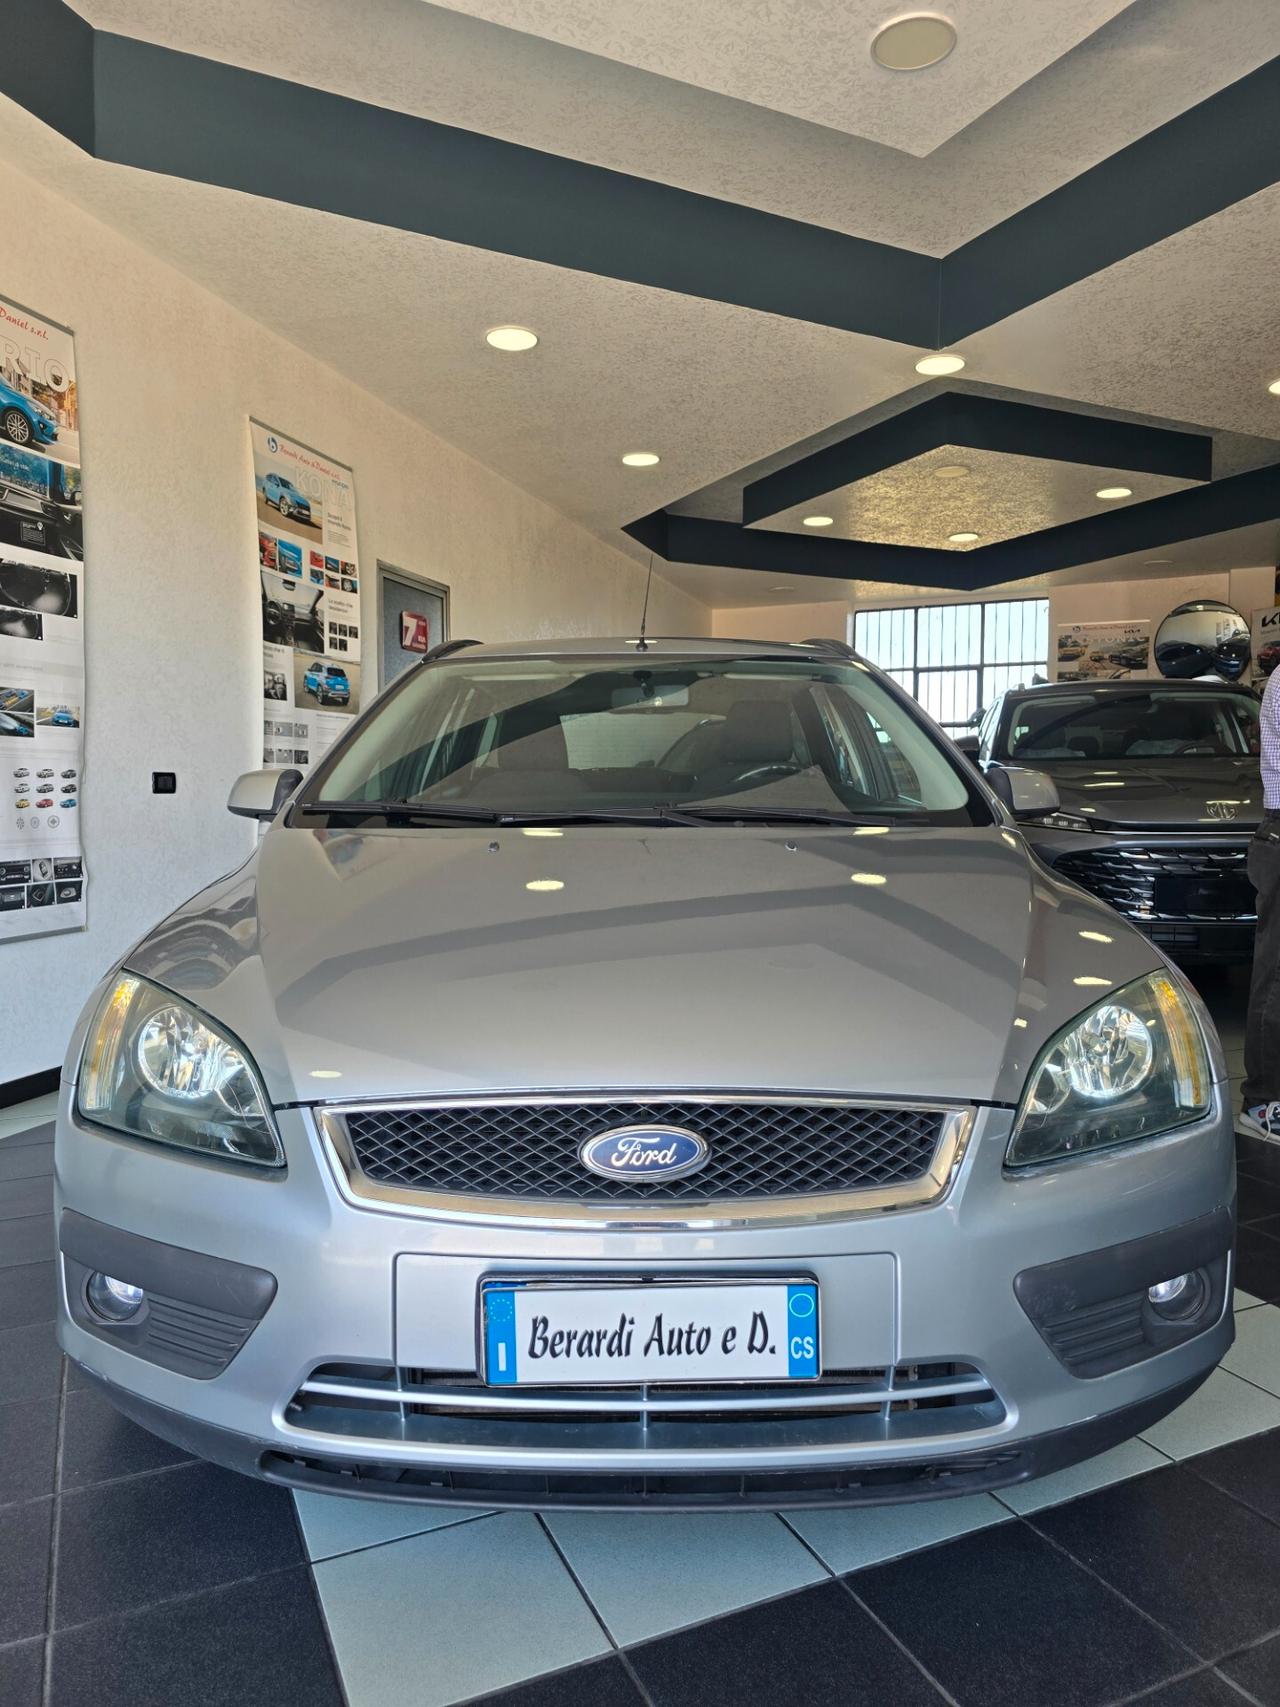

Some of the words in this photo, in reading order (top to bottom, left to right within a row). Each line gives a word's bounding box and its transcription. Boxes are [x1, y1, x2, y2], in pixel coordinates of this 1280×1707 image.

[0, 306, 29, 330] Daniel
[403, 613, 417, 647] 7
[611, 1137, 677, 1166] Ford
[528, 1313, 636, 1359] Berardi
[643, 1313, 712, 1357] Auto
[721, 1323, 737, 1356] e
[747, 1310, 776, 1355] D.
[790, 1336, 814, 1360] CS
